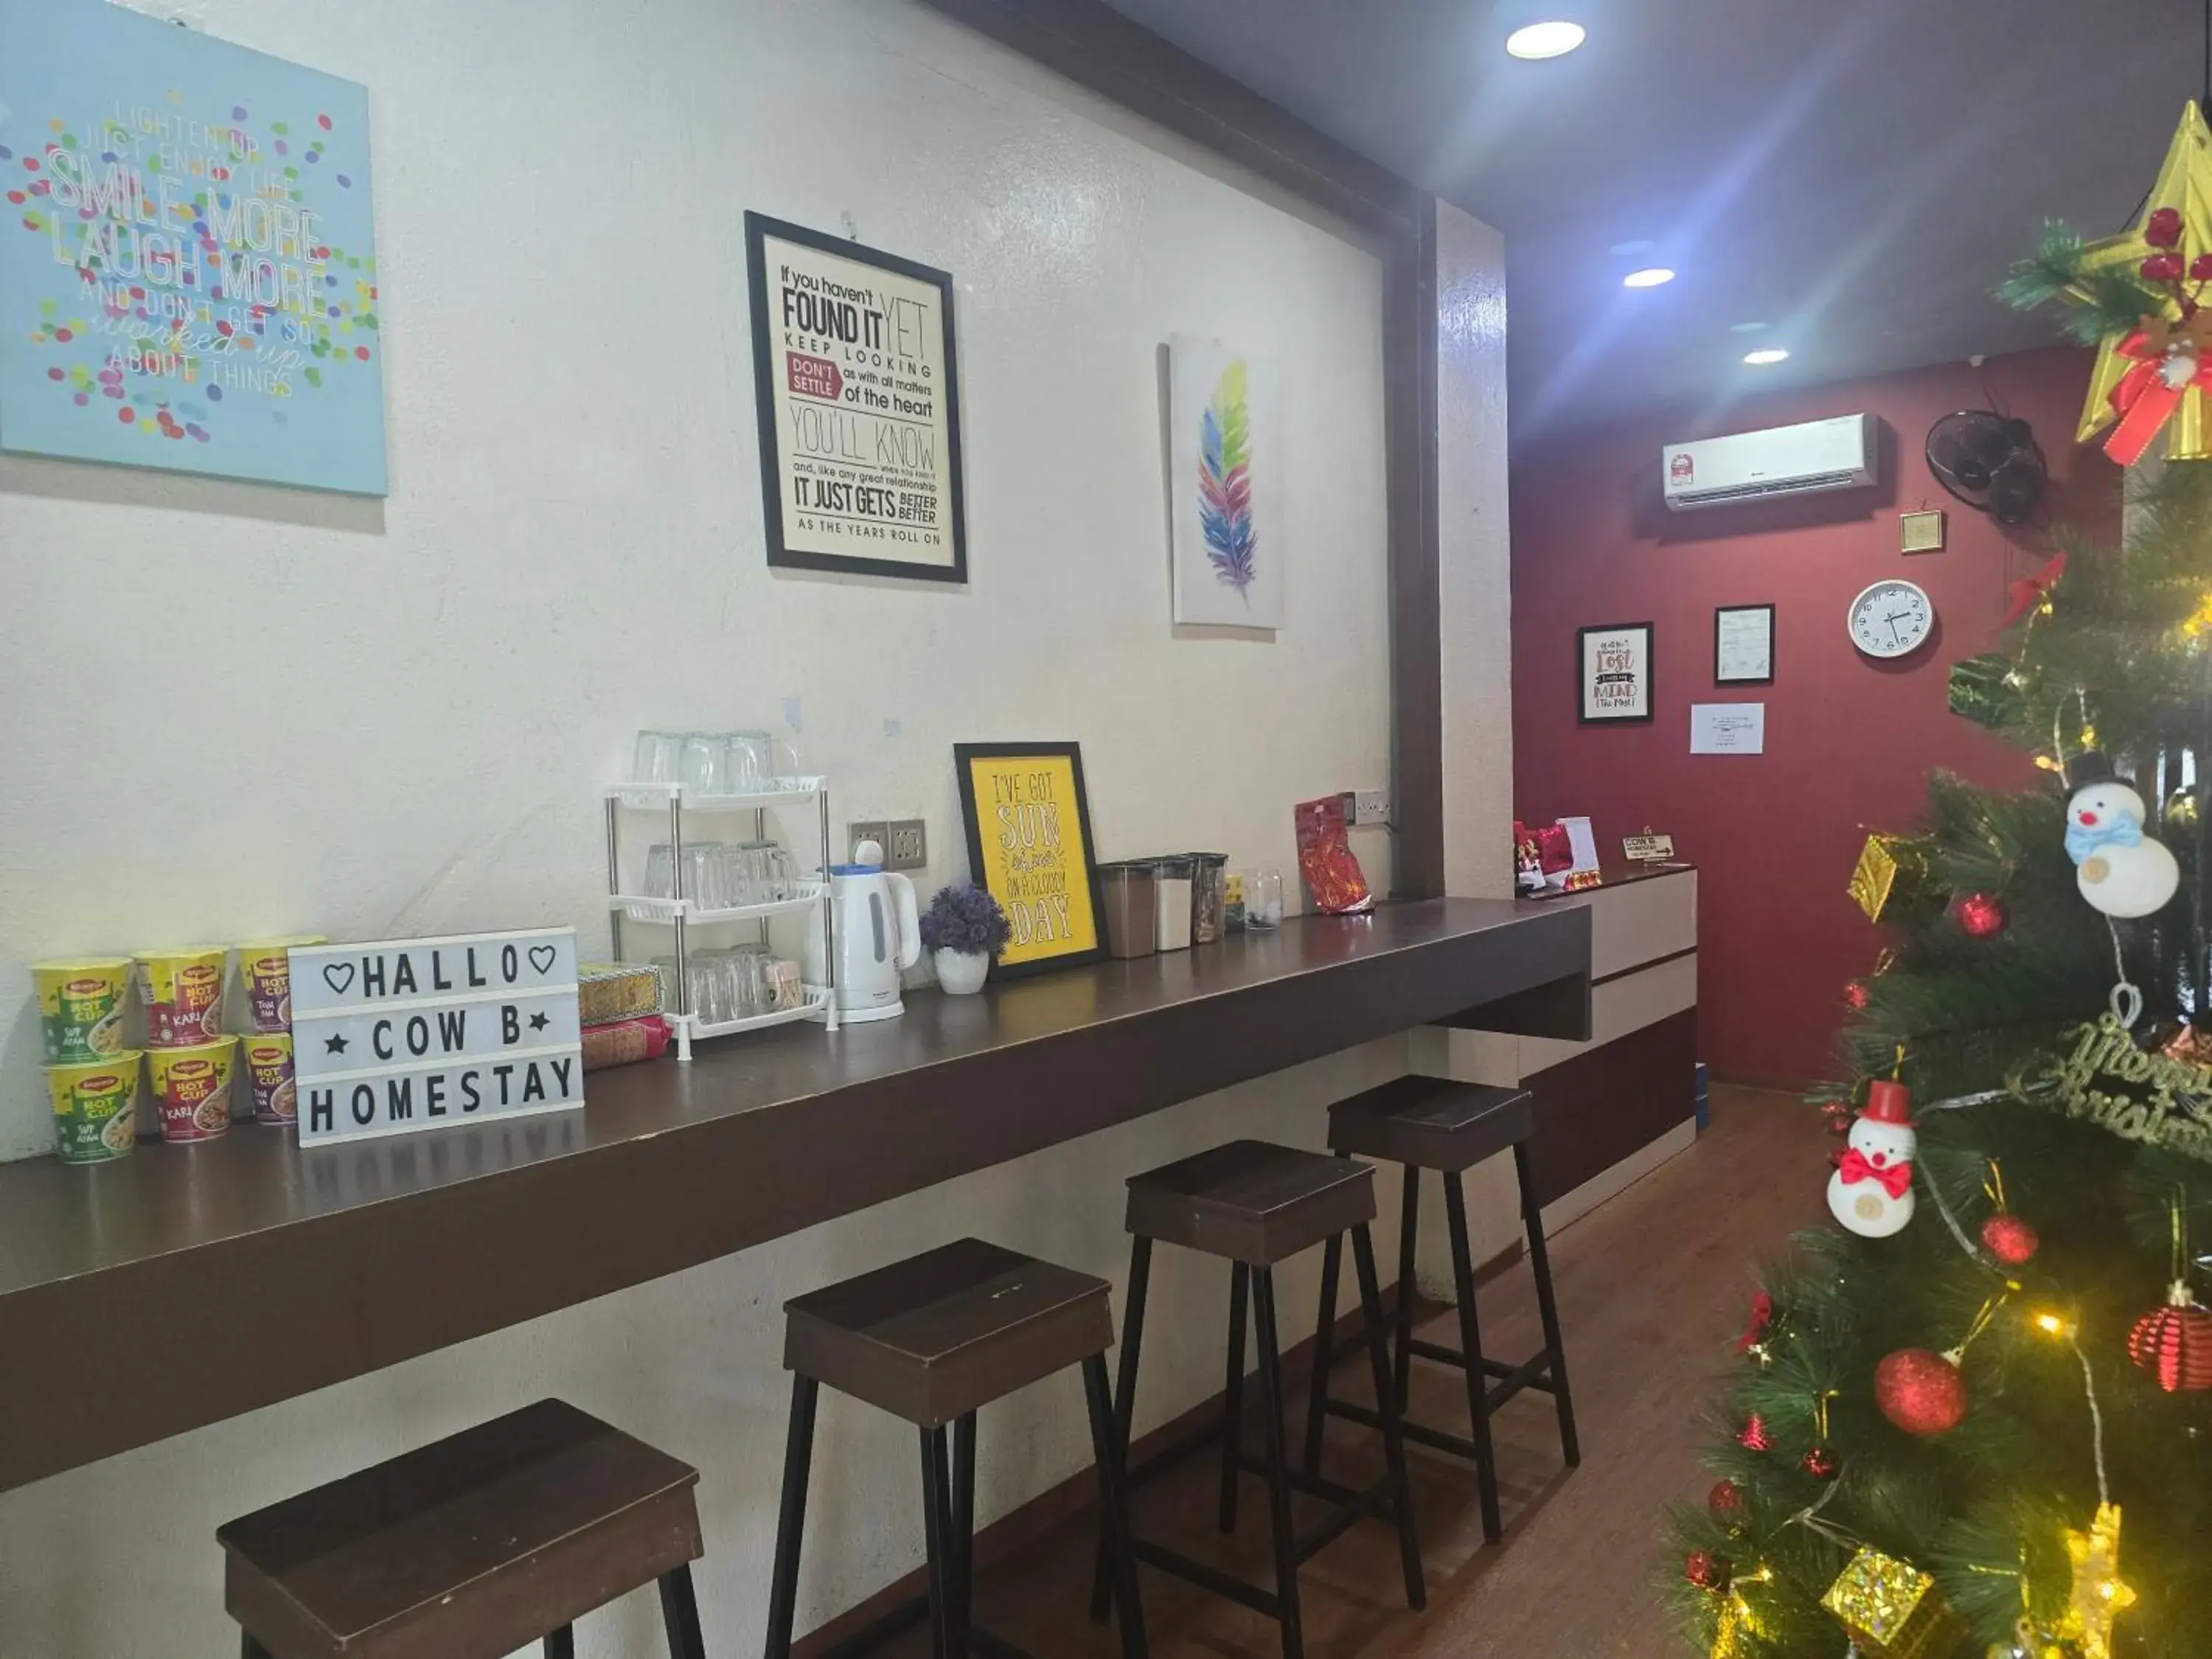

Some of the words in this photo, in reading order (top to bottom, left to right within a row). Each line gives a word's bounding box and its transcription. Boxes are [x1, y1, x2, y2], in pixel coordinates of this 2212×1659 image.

[115, 99, 219, 152] LIGHTEN
[231, 131, 260, 161] UP
[83, 122, 145, 160] JUST
[160, 142, 240, 184] ENJOY
[251, 167, 296, 204] LIFE
[48, 147, 187, 234] SMILE
[207, 187, 326, 266] MORE
[51, 210, 202, 293] LAUGH
[220, 248, 328, 319] MORE
[781, 264, 790, 282] If
[792, 271, 819, 293] you
[822, 276, 874, 306] haven't
[80, 276, 131, 310] AND
[228, 307, 275, 336] GET
[281, 317, 313, 346] SO
[782, 286, 859, 344] FOUND
[864, 308, 883, 350] IT
[880, 293, 929, 360] YET
[90, 308, 240, 357] worked
[254, 347, 305, 386] up
[785, 332, 831, 355] KEEP
[845, 347, 931, 378] LOOKING
[110, 344, 196, 383] ABOUT
[207, 358, 293, 398] THINGS
[793, 358, 833, 380] DON'T
[793, 375, 833, 397] SETTLE
[843, 368, 856, 380] as
[858, 371, 879, 384] with
[881, 375, 894, 388] all
[896, 380, 932, 397] matters
[845, 386, 860, 403] of
[863, 388, 889, 408] the
[893, 394, 933, 418] heart
[790, 406, 867, 460] YOU'LL
[876, 421, 935, 470] KNOW
[794, 476, 810, 506] IT
[814, 480, 853, 512] JUST
[855, 486, 896, 518] GETS
[899, 492, 937, 510] BETTER
[818, 466, 835, 477] like
[839, 469, 857, 481] any
[859, 472, 884, 484] great
[886, 477, 937, 493] relationship
[798, 518, 813, 530] AS
[820, 520, 841, 533] THE
[847, 524, 886, 539] YEARS
[891, 529, 919, 543] ROLL
[924, 534, 940, 546] ON
[899, 507, 936, 524] BETTER
[992, 773, 1021, 803] I'VE
[1029, 772, 1054, 802] GOT
[997, 802, 1061, 849] SUN
[1009, 894, 1074, 947] DAY
[261, 976, 288, 989] HOT
[362, 944, 518, 998] HALLO
[372, 1009, 466, 1060] COW
[501, 1005, 521, 1046] B
[176, 1079, 205, 1092] HOT
[256, 1066, 281, 1077] HOT
[259, 1076, 284, 1085] CUP
[83, 1096, 115, 1110] HOT
[180, 1089, 209, 1101] CUP
[310, 1057, 572, 1133] HOMESTAY
